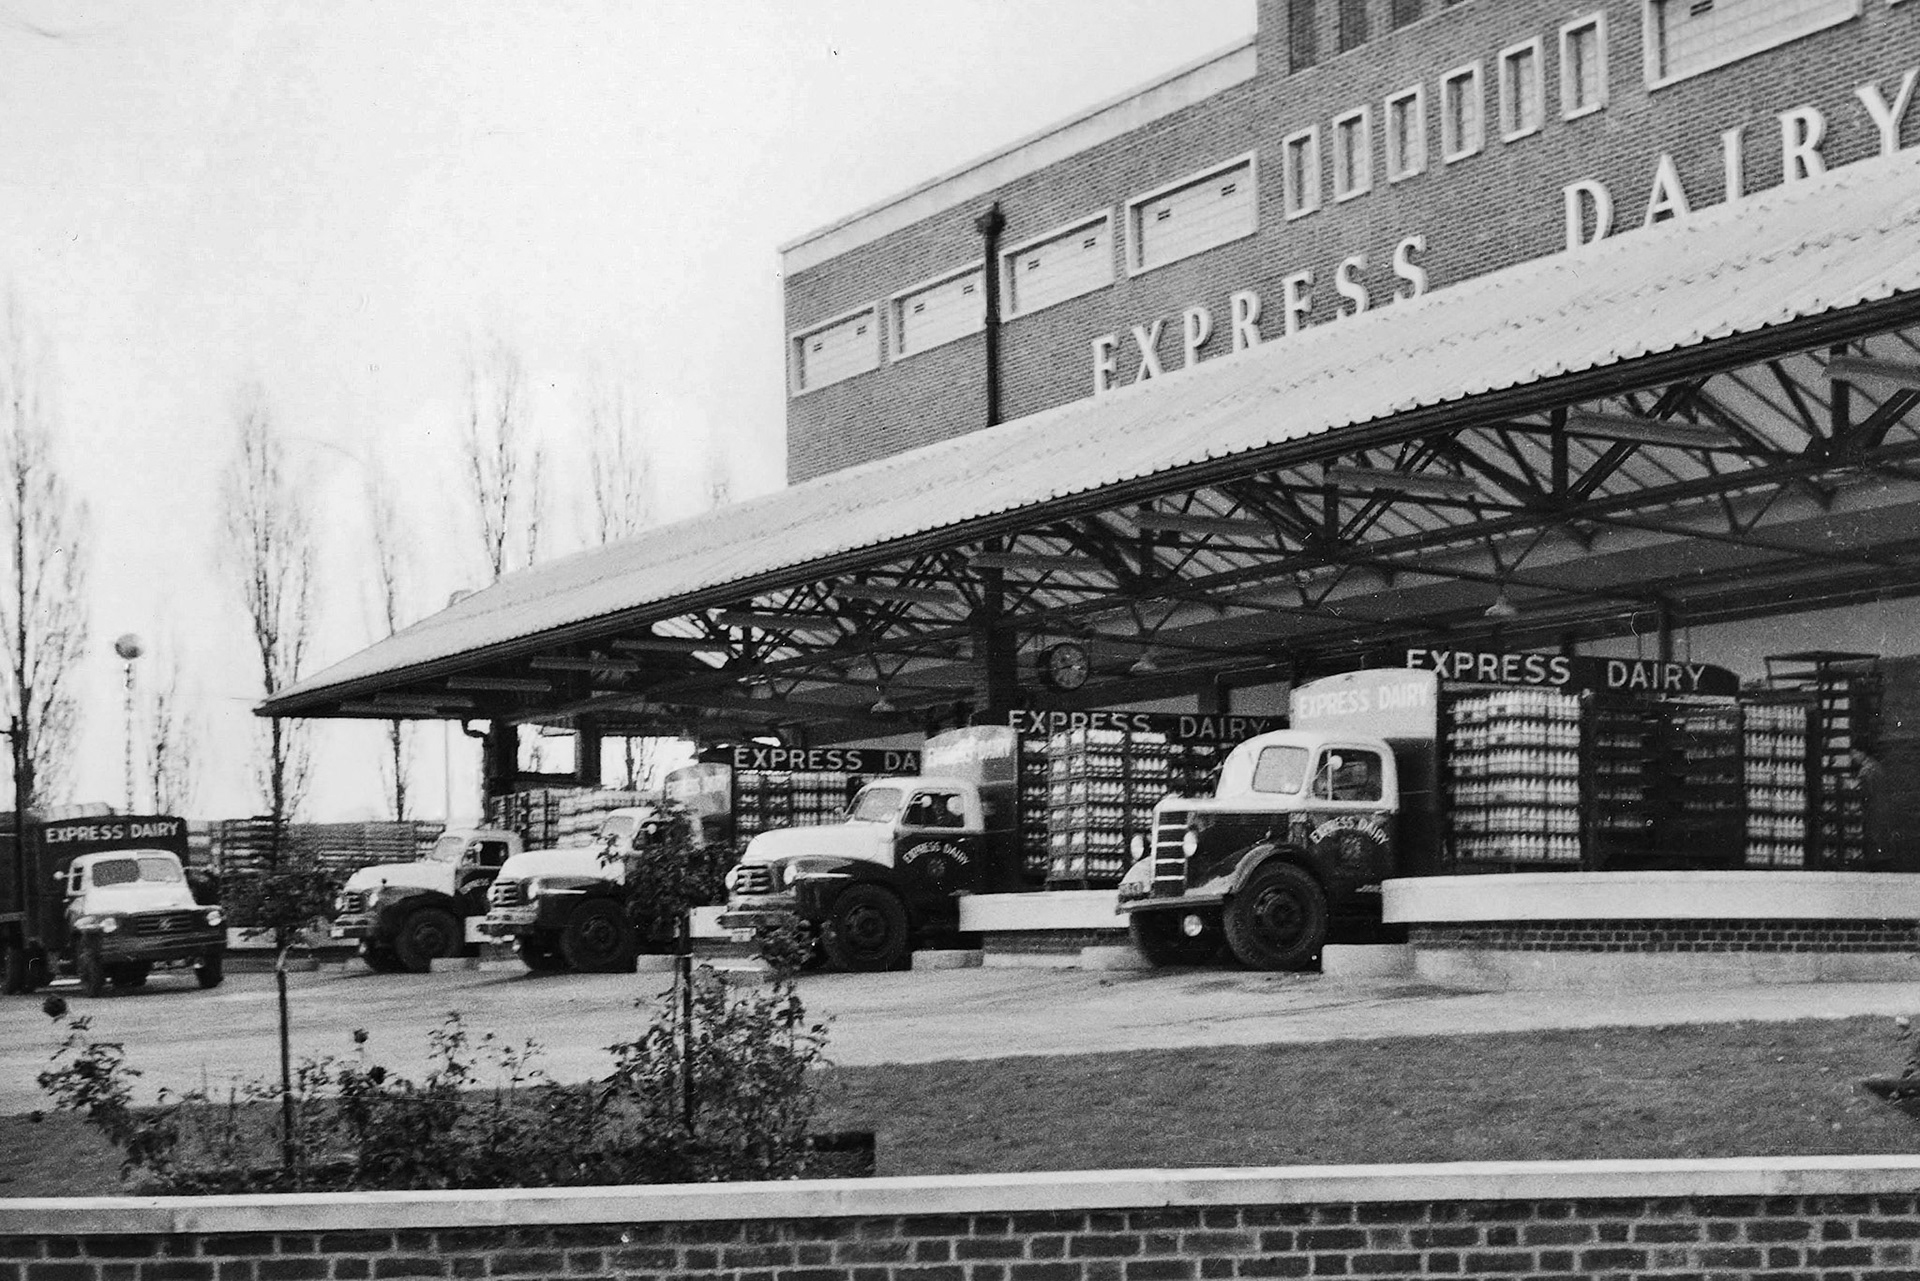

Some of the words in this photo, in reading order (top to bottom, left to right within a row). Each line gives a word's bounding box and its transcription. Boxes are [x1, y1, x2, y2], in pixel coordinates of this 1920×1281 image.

[1091, 234, 1429, 393] EXPRESS
[1563, 68, 1920, 251] DAIRY
[1406, 649, 1571, 685] EXPRESS
[1607, 660, 1705, 691] DAIRY
[1008, 709, 1150, 734] EXPRESS
[1179, 716, 1266, 740] DAIRY
[733, 747, 863, 770] EXPRESS
[45, 824, 124, 843] EXPRESS
[130, 821, 179, 839] DAIRY
[1356, 817, 1390, 846] DAIRY
[942, 843, 970, 866] DAIRY
